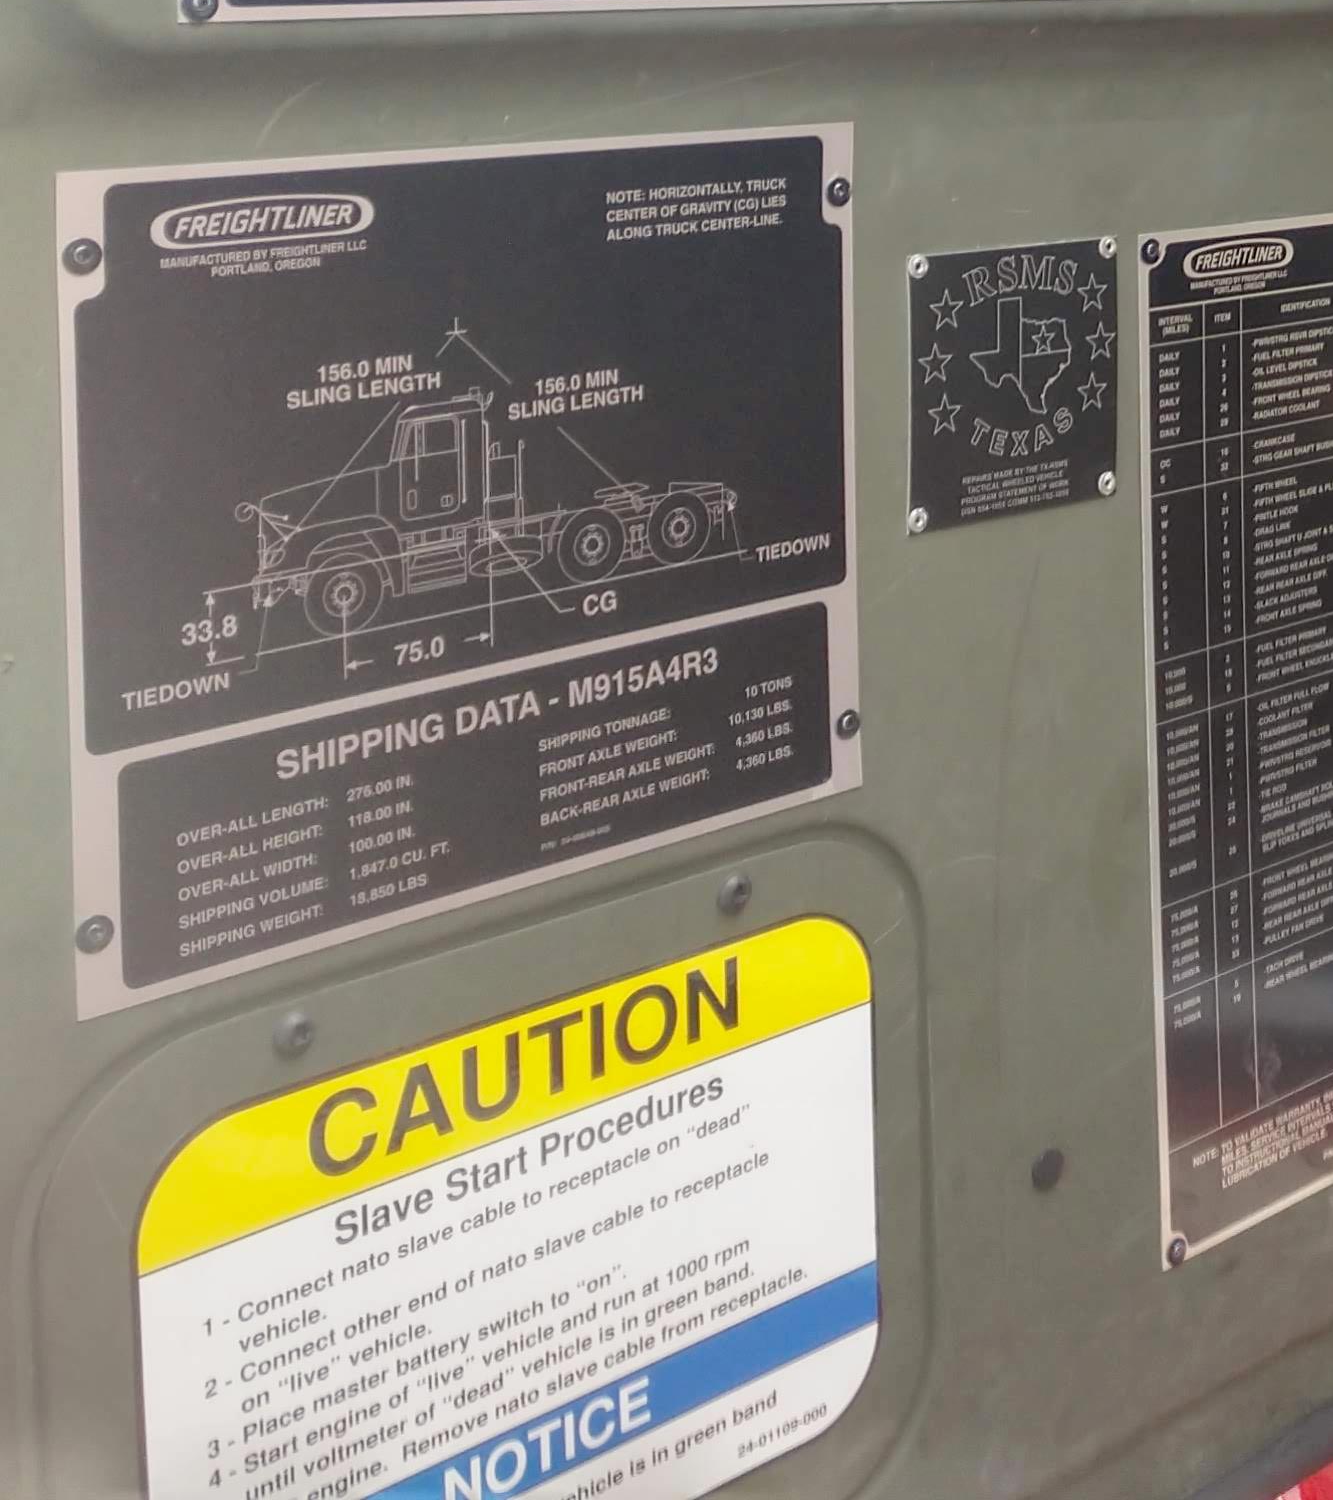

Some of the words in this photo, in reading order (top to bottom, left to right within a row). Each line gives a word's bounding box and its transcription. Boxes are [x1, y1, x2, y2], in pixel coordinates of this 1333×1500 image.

[605, 188, 646, 205] NOTE:
[744, 176, 787, 193] TRUCK
[173, 202, 354, 241] FREIGHTLINER
[1195, 242, 1285, 271] FREIGHTLINER
[961, 254, 1080, 309] RSMS
[1213, 310, 1232, 324] ITEM
[1279, 296, 1332, 314] IDENTIFICATION
[316, 359, 371, 384] 156.0
[374, 353, 413, 376] MIN
[534, 373, 582, 397] 156.0
[584, 367, 619, 390] MIN
[285, 382, 352, 410] SLING
[357, 370, 442, 400] LENGTH
[507, 395, 566, 421] SLING
[569, 383, 644, 412] LENGTH
[969, 406, 1074, 457] TEXAS
[1158, 425, 1181, 440] DAILY
[754, 532, 831, 564] TIEDOWN
[581, 589, 618, 617] CG
[180, 613, 238, 647] 33.8
[392, 634, 445, 667] 75.0
[120, 671, 230, 711] TIEDOWN
[275, 712, 445, 780] SHIPPING
[455, 689, 541, 736] DATA
[567, 645, 719, 708] M915A4R3
[175, 814, 259, 847] OVER-ALL
[261, 795, 329, 825] LENGTH:
[345, 777, 394, 803] 276.00
[394, 773, 414, 790] IN.
[308, 954, 739, 1177] CAUTION
[334, 1187, 434, 1246] Slave
[445, 1145, 528, 1202] Start
[539, 1075, 724, 1167] Procedures
[202, 1316, 212, 1337] 1
[236, 1268, 335, 1323] Connect
[341, 1250, 391, 1282] nato
[396, 1224, 454, 1259] slave
[459, 1199, 517, 1234] cable
[521, 1189, 543, 1209] to
[548, 1146, 651, 1199] receptacle
[655, 1134, 681, 1155] on
[237, 1308, 327, 1353] vehicle.
[207, 1438, 221, 1460] 3
[242, 1405, 306, 1445] Place
[312, 1368, 390, 1414] master
[395, 1331, 471, 1378] battery
[477, 1299, 544, 1342] switch
[549, 1290, 570, 1310] to
[240, 1389, 270, 1414] on
[347, 1322, 433, 1367] vehicle.
[444, 1376, 652, 1500] NOTICE
